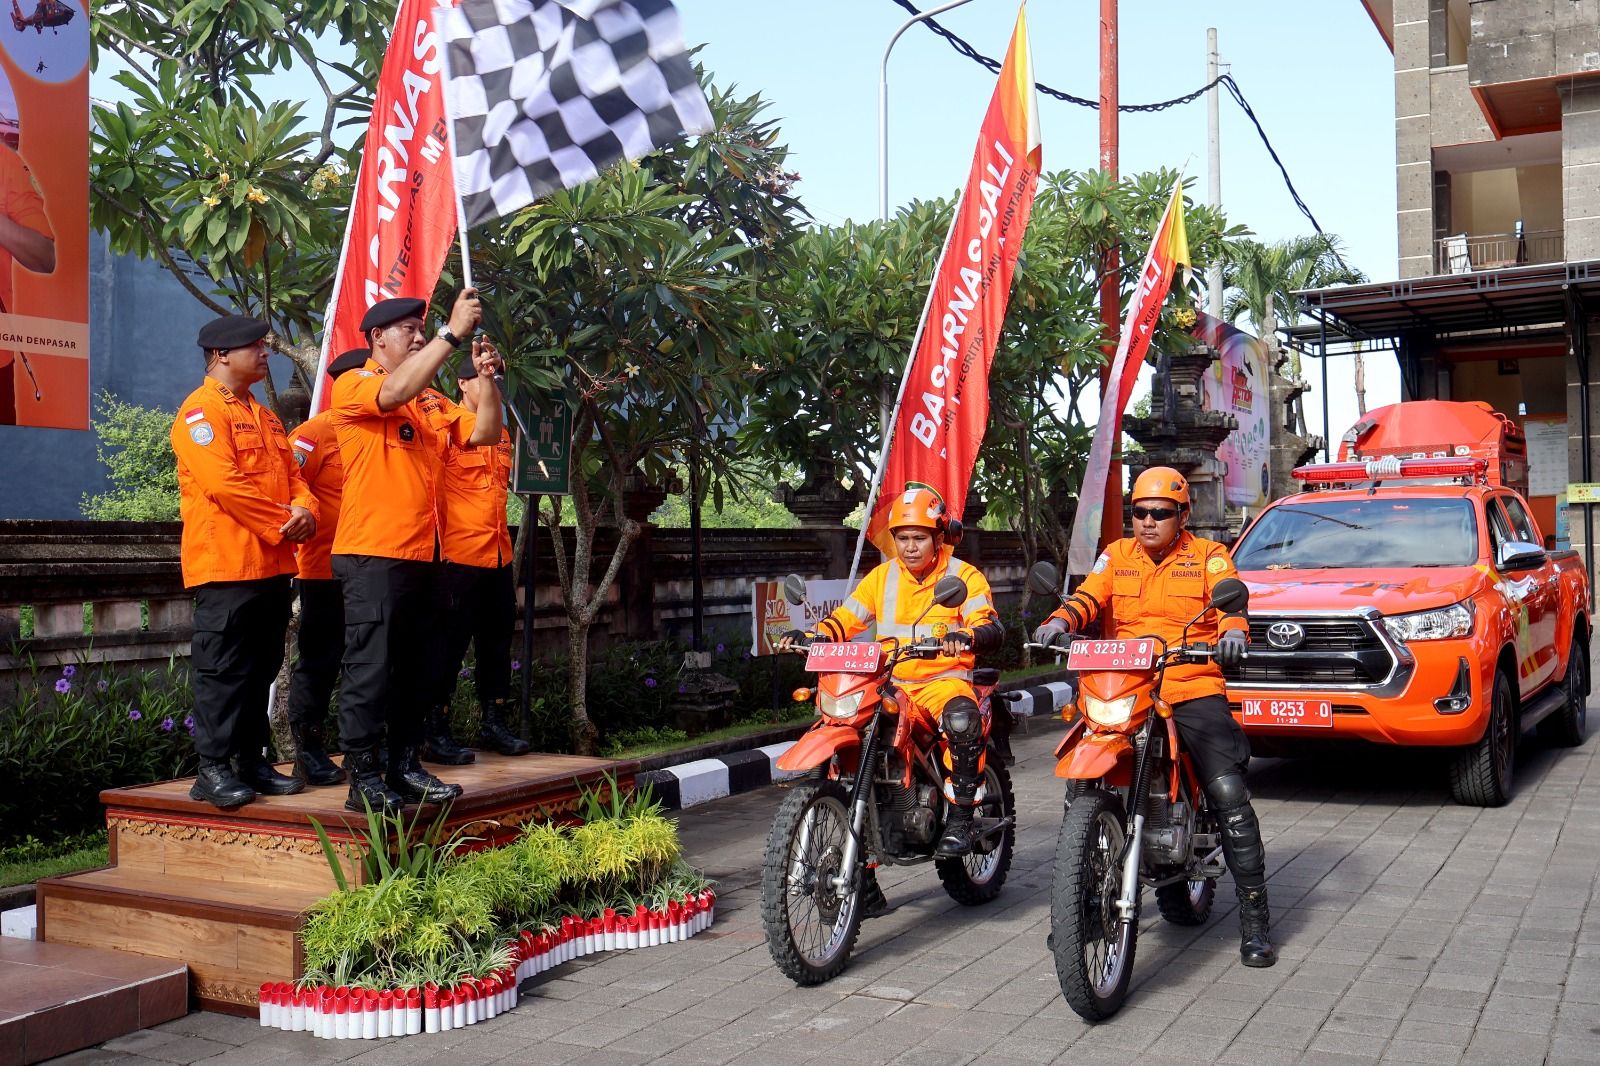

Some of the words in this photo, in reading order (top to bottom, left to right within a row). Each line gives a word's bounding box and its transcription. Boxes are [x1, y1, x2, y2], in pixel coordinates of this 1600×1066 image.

[0, 333, 23, 343] GAN
[26, 336, 76, 349] DENPASAR
[1171, 570, 1202, 578] BASARNAS
[811, 645, 826, 657] DK
[830, 645, 858, 657] 2813
[1072, 642, 1090, 654] DK
[1094, 642, 1126, 654] 3235
[1244, 700, 1263, 716] DK
[1270, 701, 1305, 717] 8253
